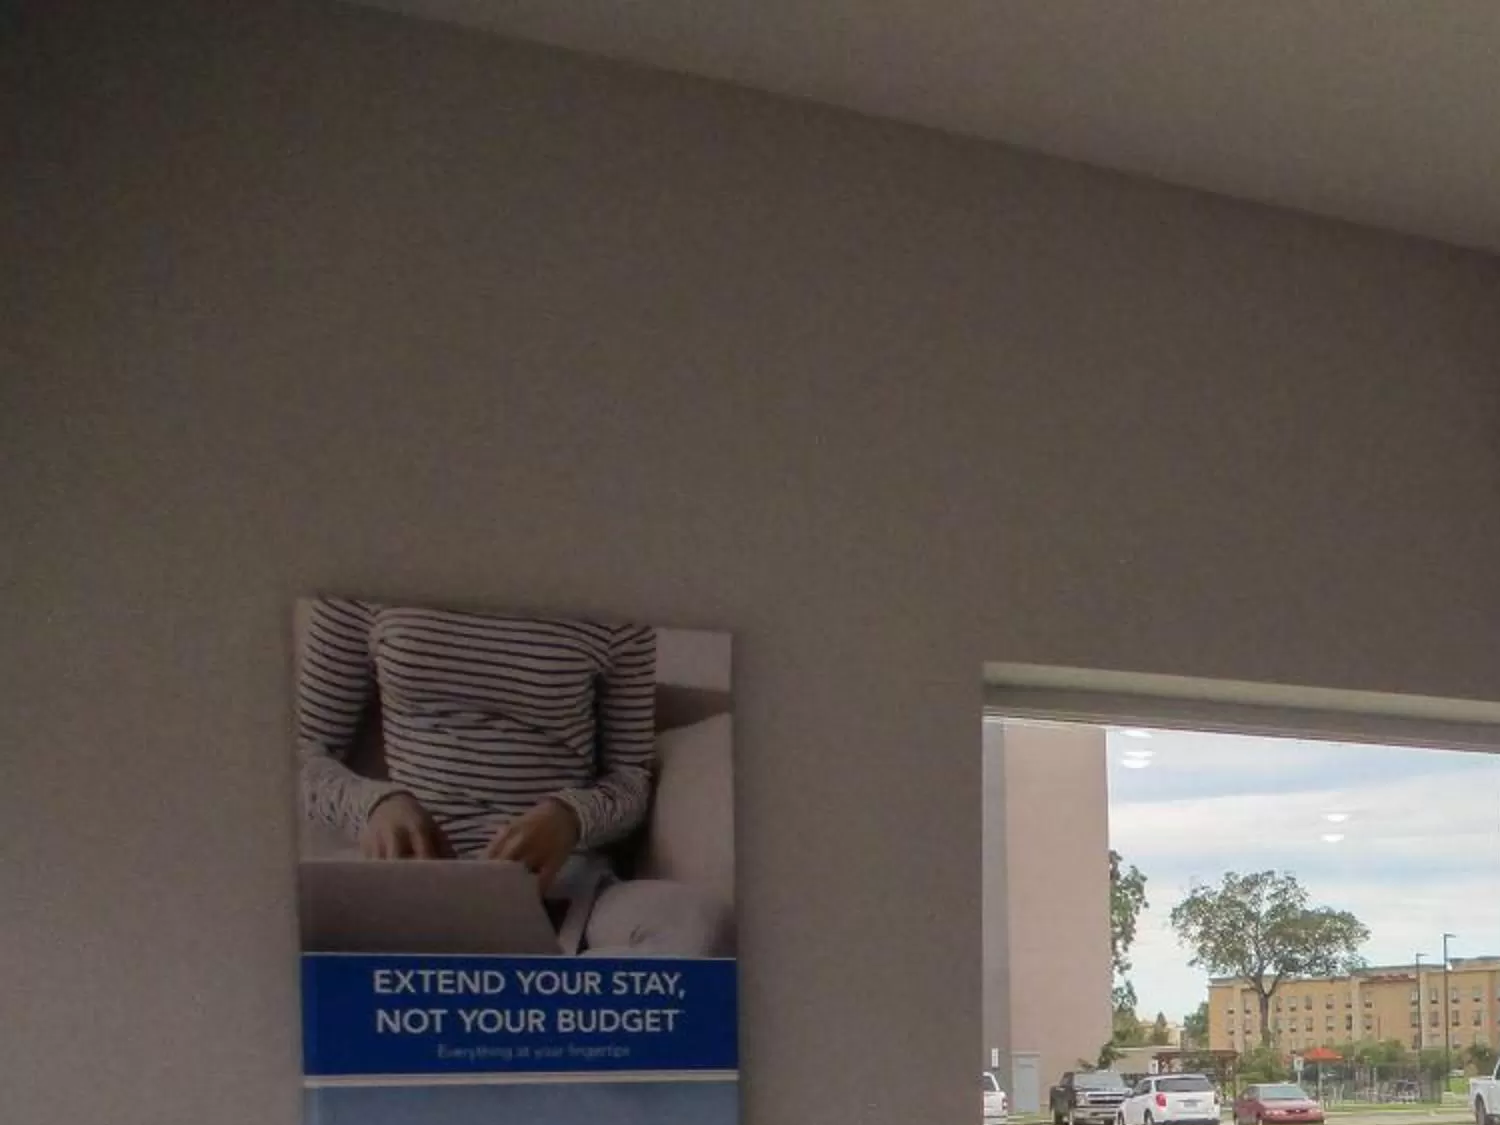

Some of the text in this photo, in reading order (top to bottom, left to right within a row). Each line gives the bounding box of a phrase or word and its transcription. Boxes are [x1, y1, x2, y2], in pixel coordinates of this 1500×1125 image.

[374, 970, 686, 998] EXTEND YOUR STAY,
[376, 1009, 677, 1034] NOT YOUR BUDGET
[437, 1043, 513, 1061] Everything
[517, 1045, 530, 1058] at
